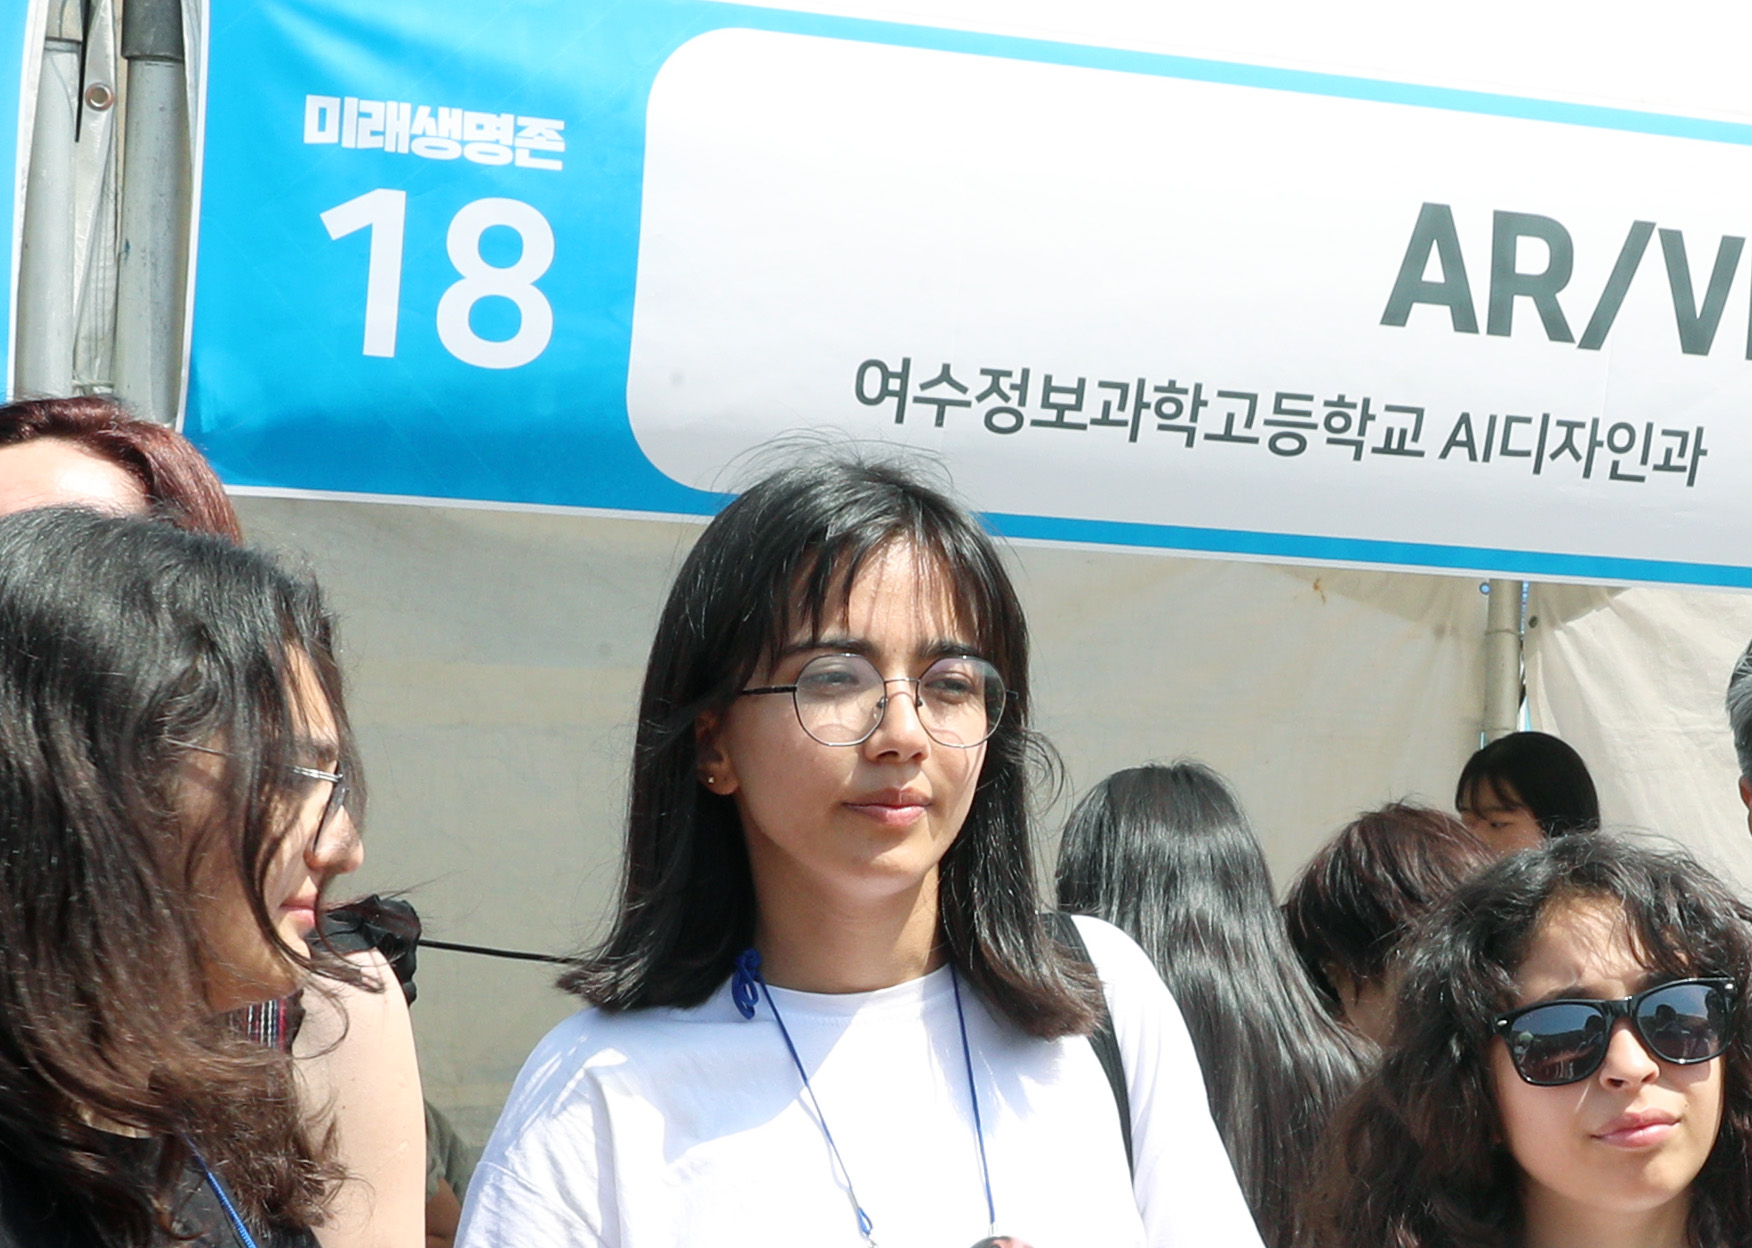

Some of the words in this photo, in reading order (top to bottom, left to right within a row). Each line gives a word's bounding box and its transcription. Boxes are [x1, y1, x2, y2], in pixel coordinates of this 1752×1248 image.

[303, 94, 566, 171] 미래생명존
[319, 187, 555, 370] 18
[854, 356, 1427, 462] 여수정보과학고등학교
[1439, 411, 1709, 488] AI디자인과
